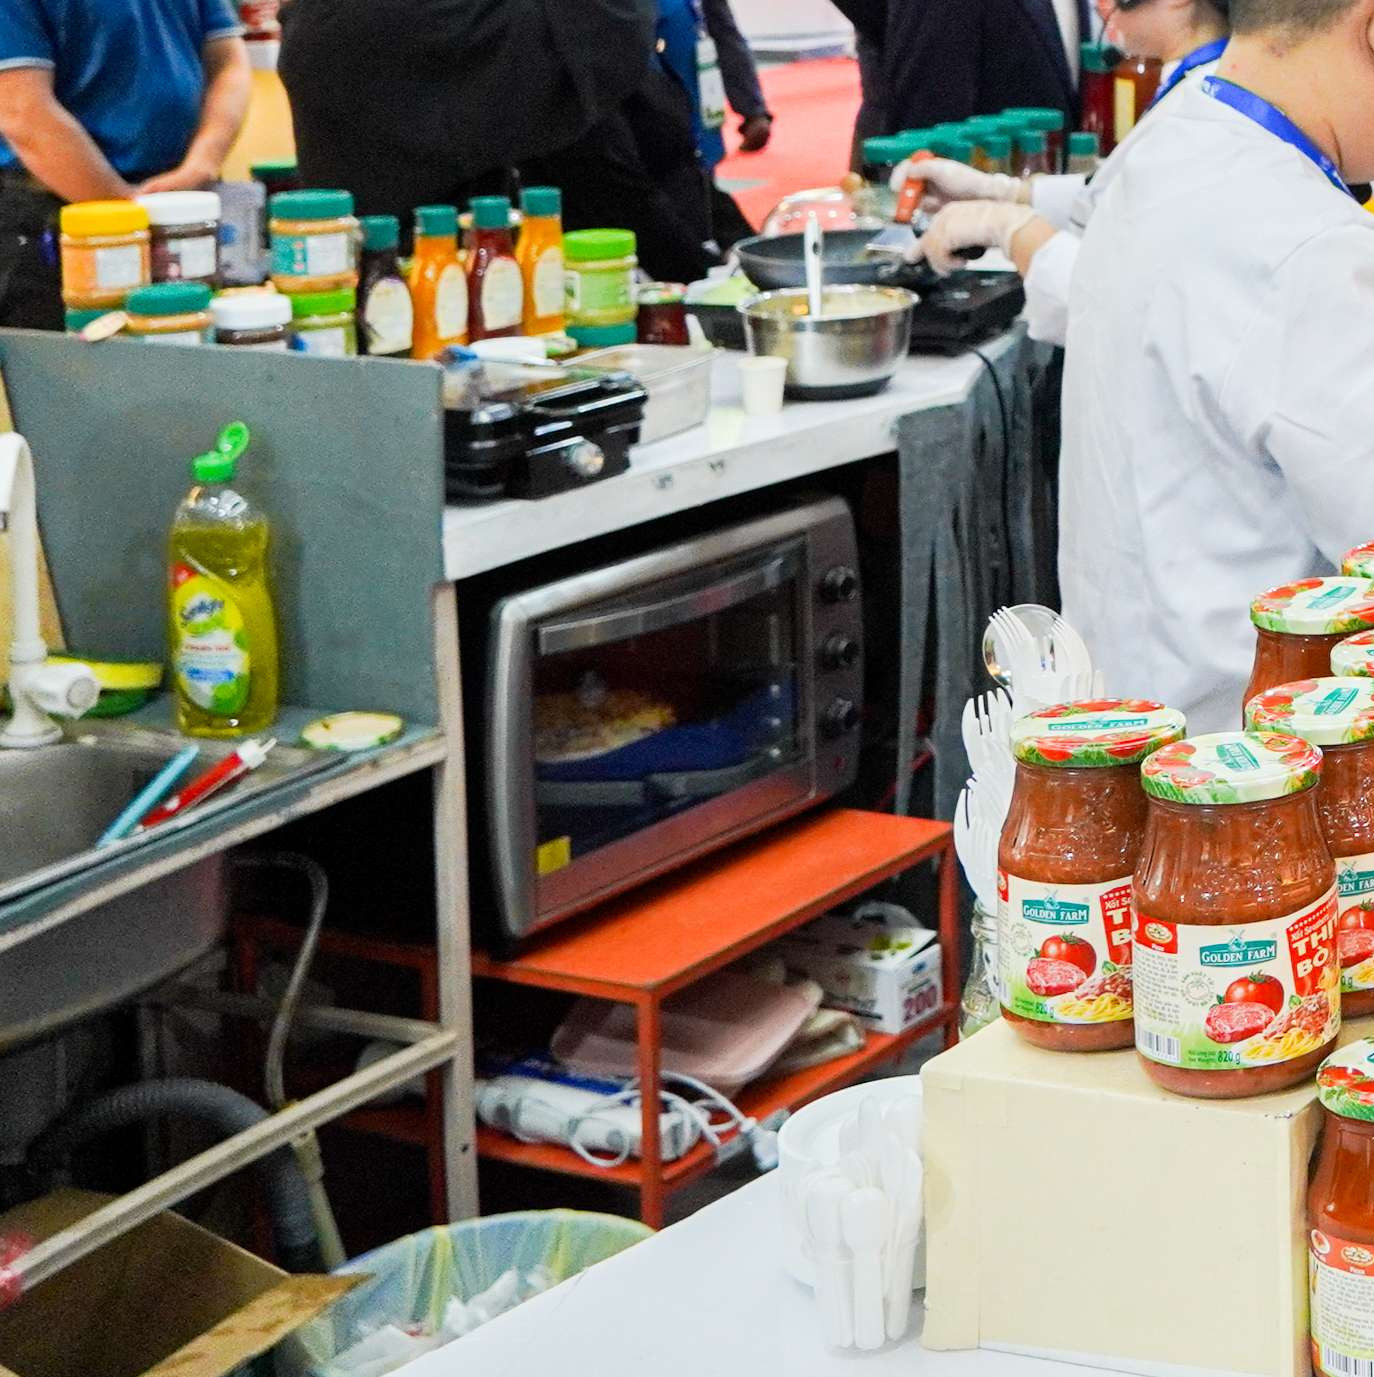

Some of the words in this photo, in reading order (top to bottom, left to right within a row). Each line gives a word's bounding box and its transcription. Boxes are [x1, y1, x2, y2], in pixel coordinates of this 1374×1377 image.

[1023, 904, 1058, 920] GOLDEN
[1060, 905, 1090, 922] FARM
[1201, 950, 1243, 964] GOLDEN
[1247, 945, 1276, 961] FARM
[1296, 944, 1330, 978] BÒ
[1217, 1050, 1233, 1063] 820
[1234, 1052, 1241, 1065] g
